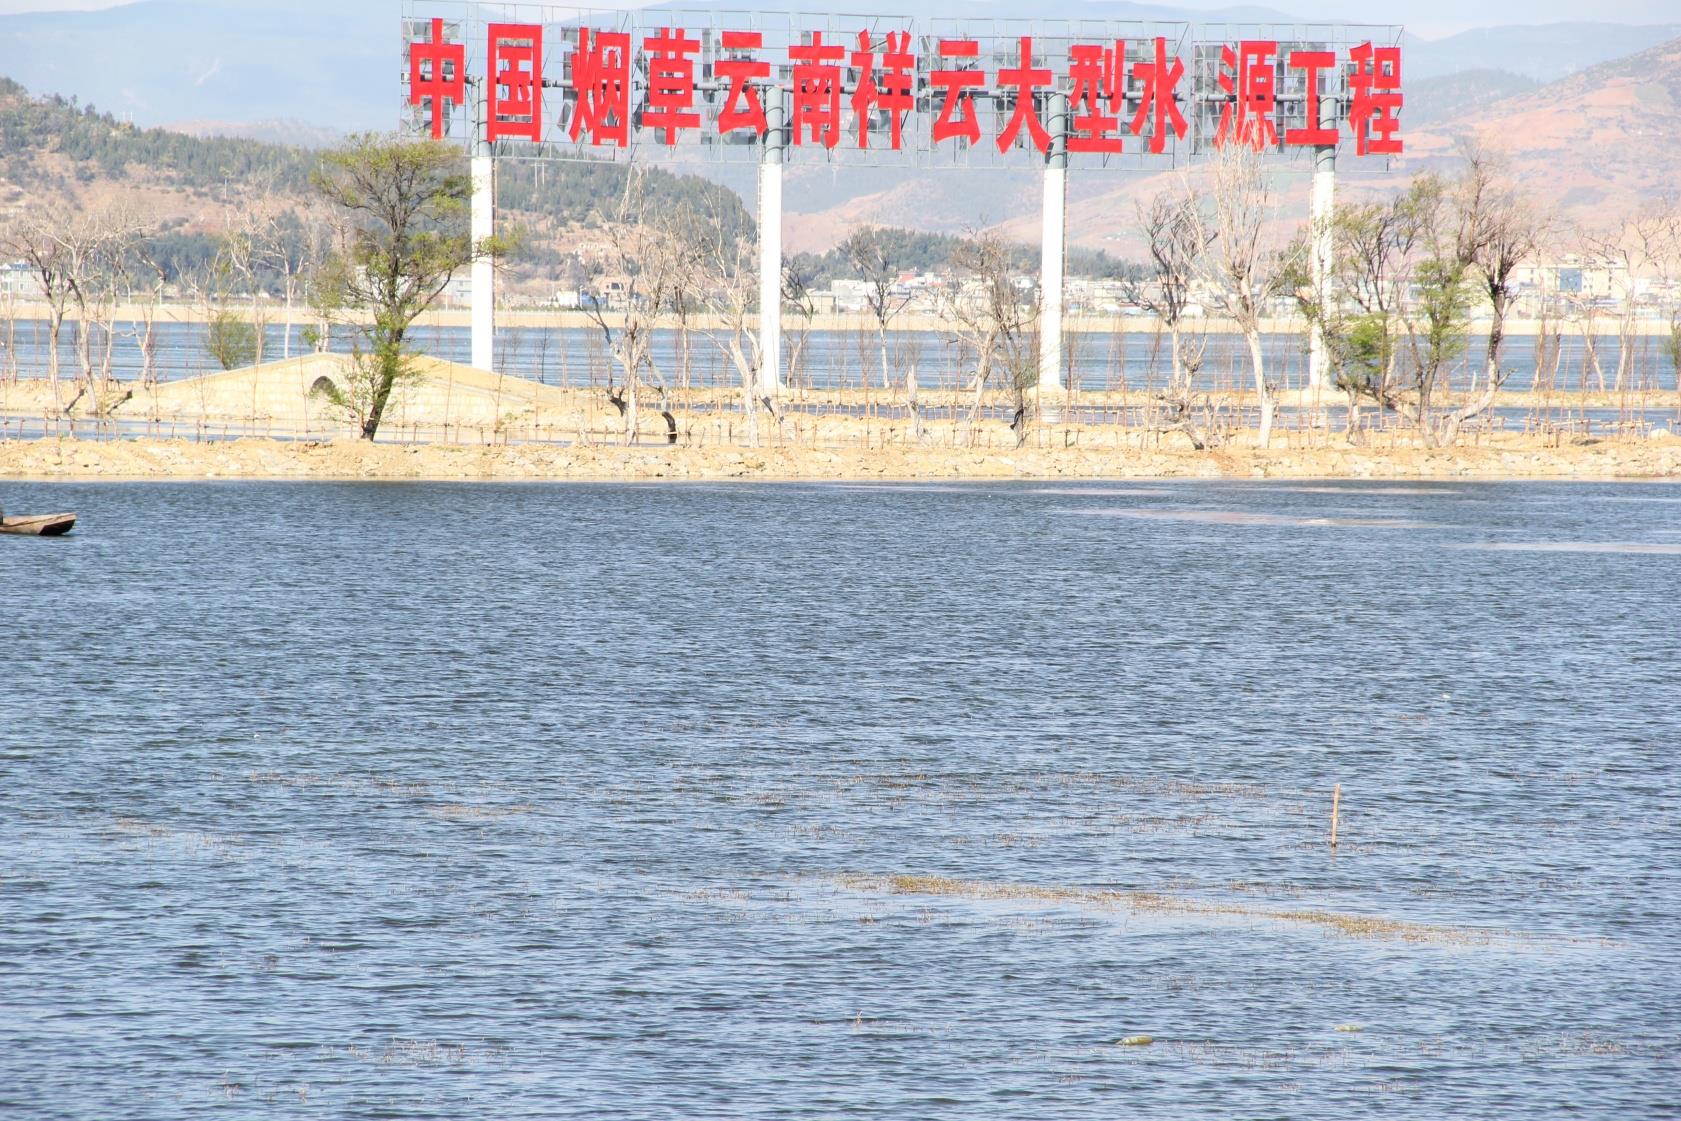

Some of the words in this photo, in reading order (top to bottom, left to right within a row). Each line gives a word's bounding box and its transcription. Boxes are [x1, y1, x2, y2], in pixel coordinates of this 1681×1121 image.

[409, 18, 1403, 155] 中国烟草云南祥云大型水源工程
